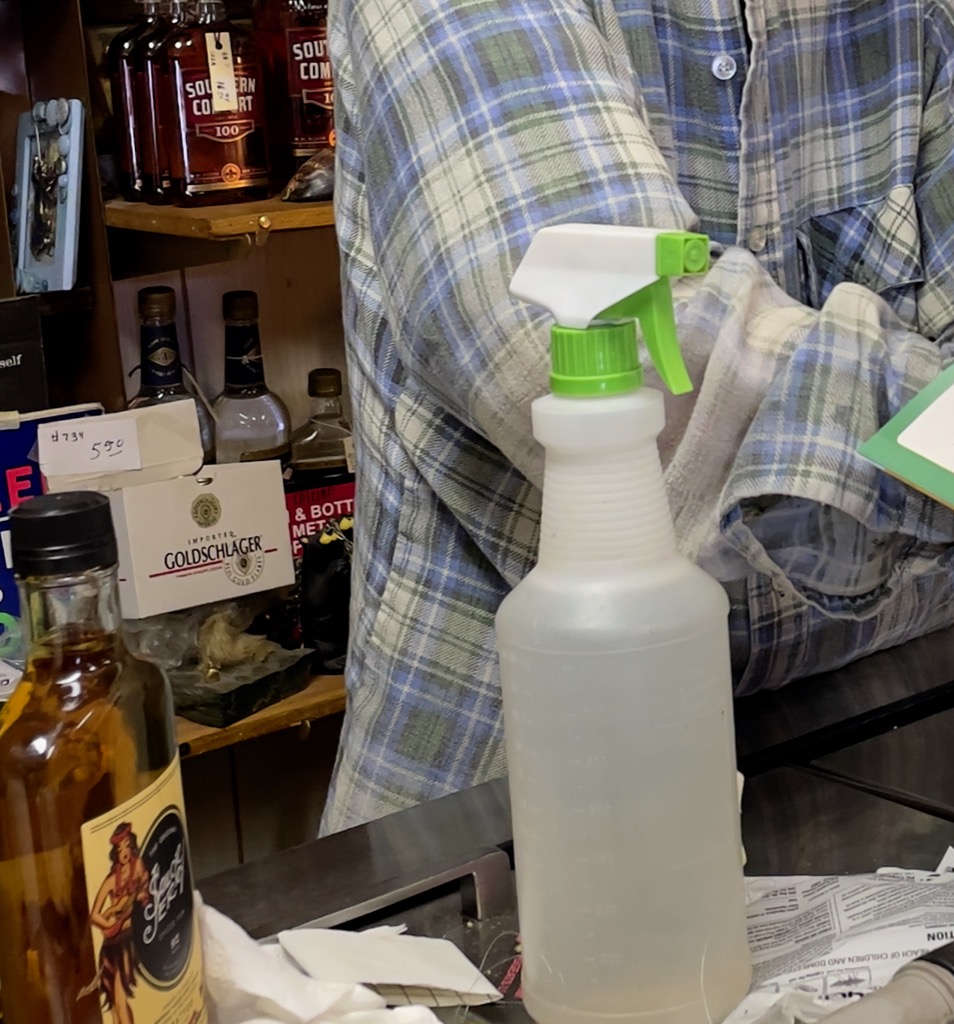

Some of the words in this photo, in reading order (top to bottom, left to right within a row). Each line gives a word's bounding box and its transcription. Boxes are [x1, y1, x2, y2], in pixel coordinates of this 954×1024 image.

[192, 96, 253, 116] CORT
[215, 125, 240, 137] 100
[295, 508, 306, 521] &
[311, 499, 355, 519] BOTT
[293, 520, 327, 538] MET
[187, 530, 238, 546] IMPORTED
[828, 957, 846, 966] AND
[849, 952, 889, 963] CHILDREN
[891, 951, 900, 959] OF
